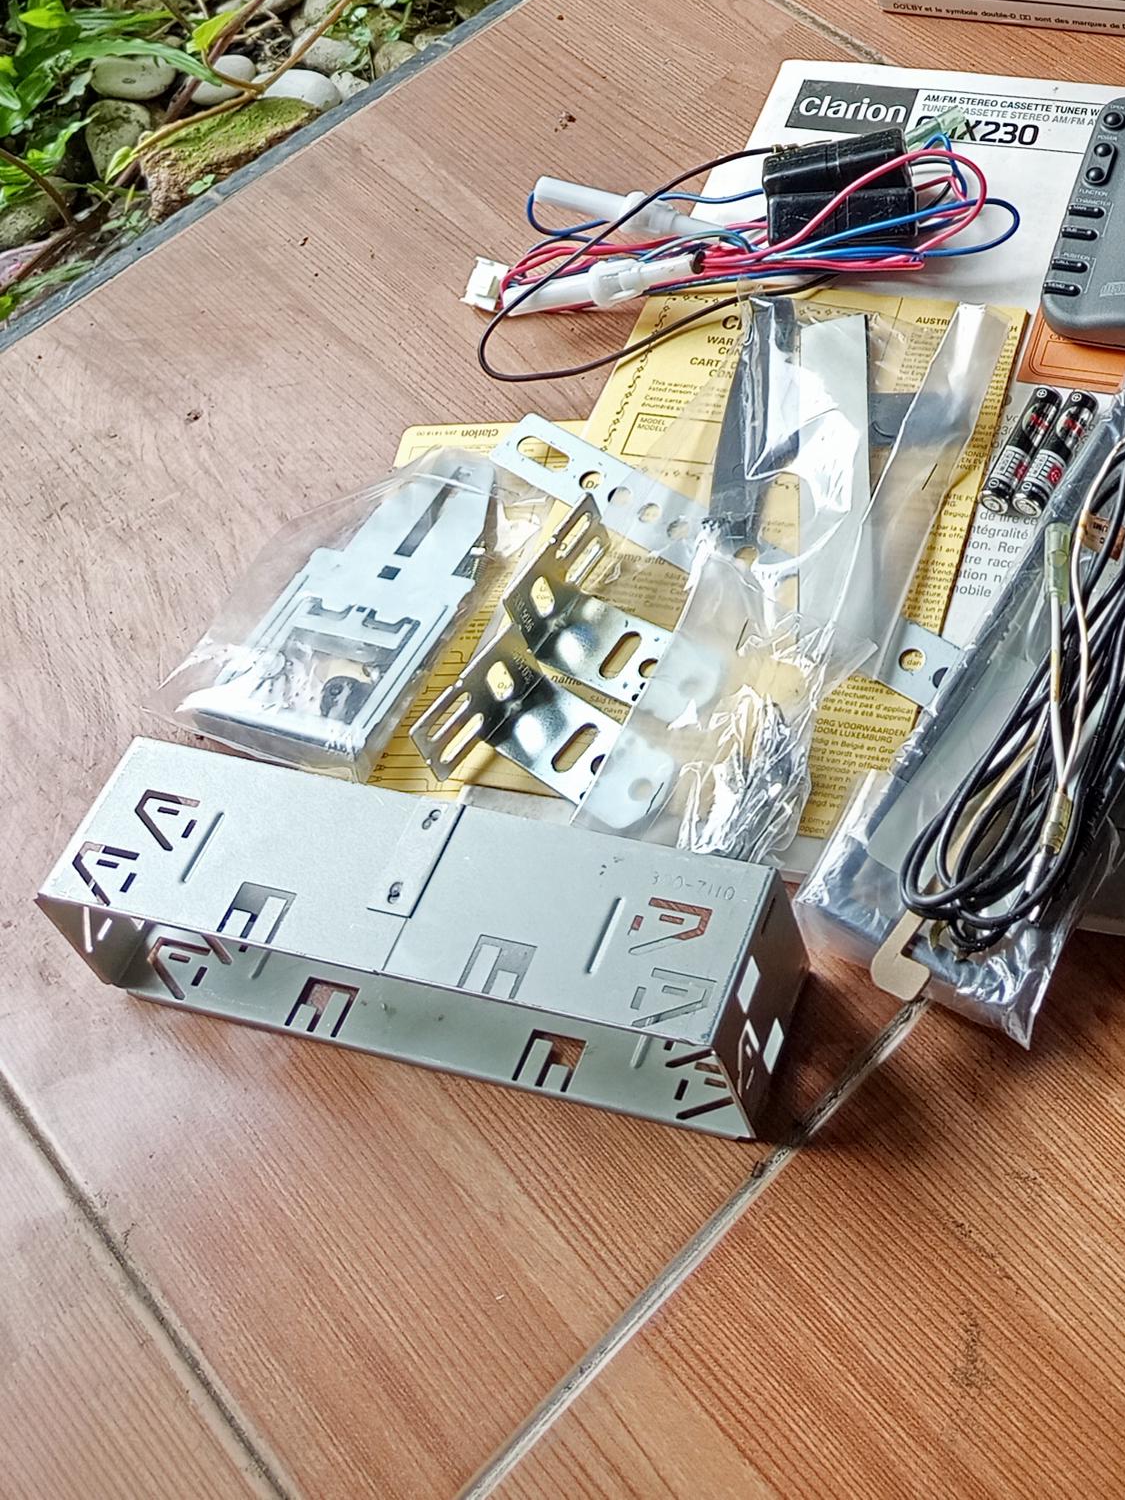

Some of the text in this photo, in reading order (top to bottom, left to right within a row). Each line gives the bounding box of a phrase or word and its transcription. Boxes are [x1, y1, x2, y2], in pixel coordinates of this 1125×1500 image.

[892, 2, 923, 12] DOLBY
[945, 8, 979, 17] symbole
[1054, 17, 1070, 25] des
[1072, 19, 1107, 29] marques
[798, 95, 907, 124] clarion
[921, 103, 953, 114] TUNE
[1010, 111, 1050, 122] STEREO
[1051, 115, 1086, 126] AM/FM
[923, 94, 957, 104] AM/FM
[958, 97, 999, 108] STEREO
[1000, 100, 1052, 112] CASSETTE
[1054, 105, 1087, 116] TUNER
[916, 115, 1040, 146] X230
[1079, 188, 1109, 197] FUNCTION
[838, 721, 907, 738] VOORWAARDEN
[839, 731, 893, 744] LUXEMBURG
